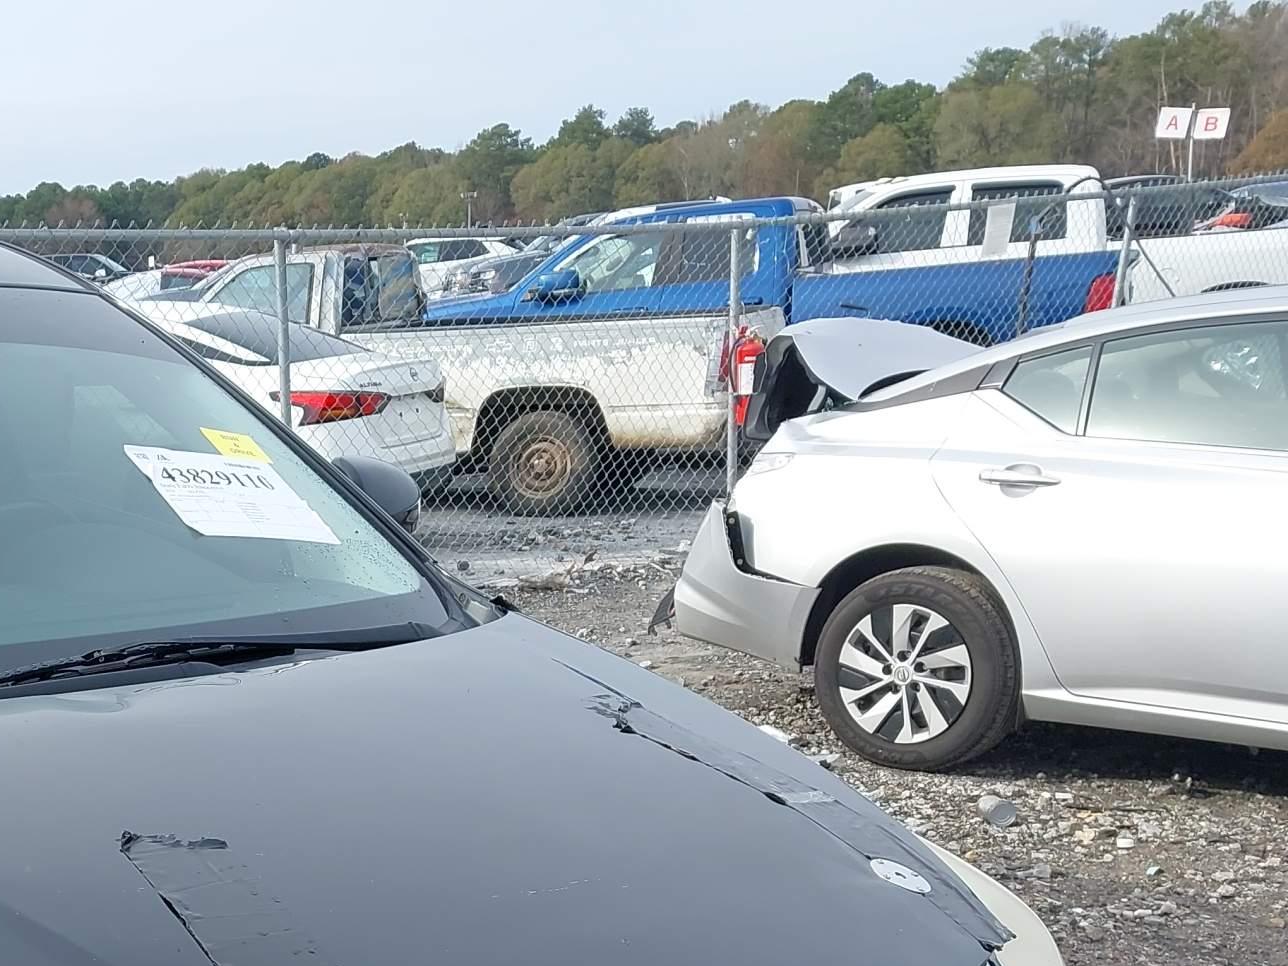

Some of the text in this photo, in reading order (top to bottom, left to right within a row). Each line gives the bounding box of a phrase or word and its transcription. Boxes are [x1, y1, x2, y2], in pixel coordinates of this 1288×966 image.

[1165, 115, 1179, 130] A
[1203, 116, 1219, 131] B
[161, 466, 275, 491] 43829110
